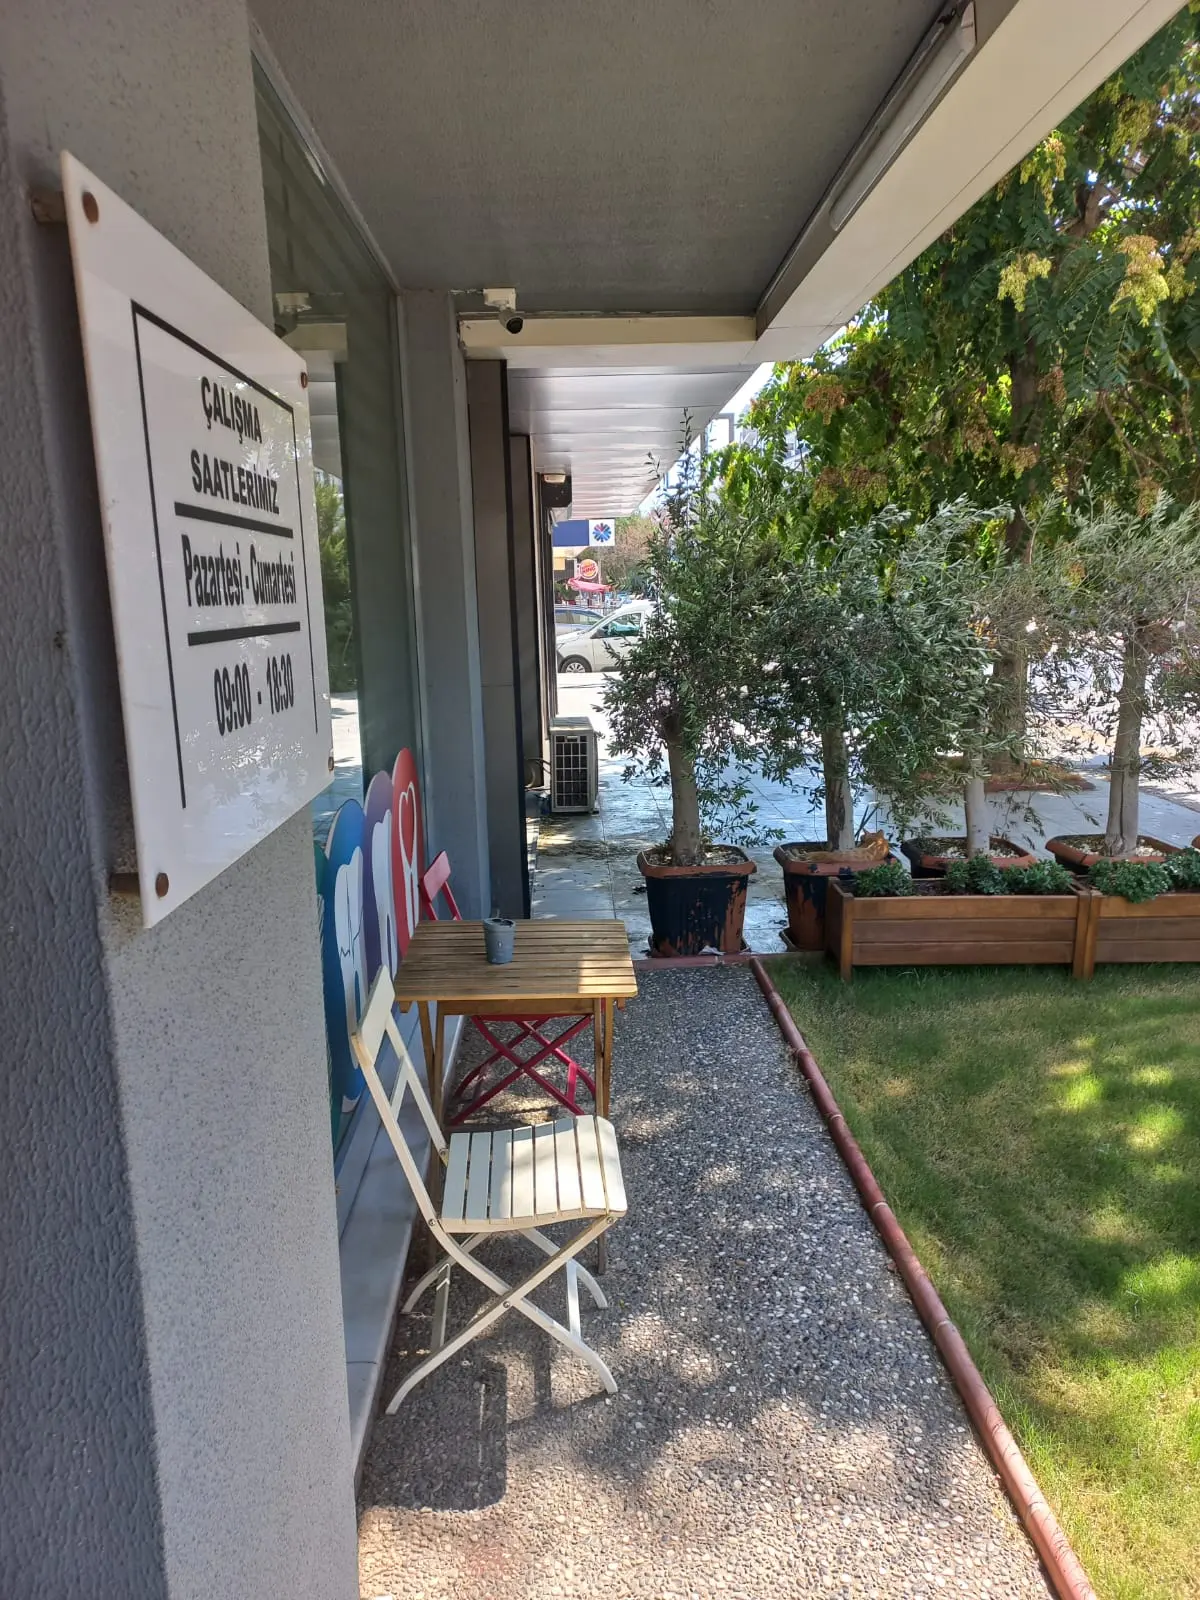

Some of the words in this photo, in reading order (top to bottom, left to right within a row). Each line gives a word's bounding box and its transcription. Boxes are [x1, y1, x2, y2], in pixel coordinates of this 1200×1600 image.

[201, 376, 262, 444] ÇALIŞMA
[191, 450, 279, 514] SAATLERİMİZ
[181, 534, 243, 607] Pazartesi
[250, 544, 297, 605] Cumartesi
[214, 663, 251, 736] 09:00
[266, 653, 294, 714] 18:30
